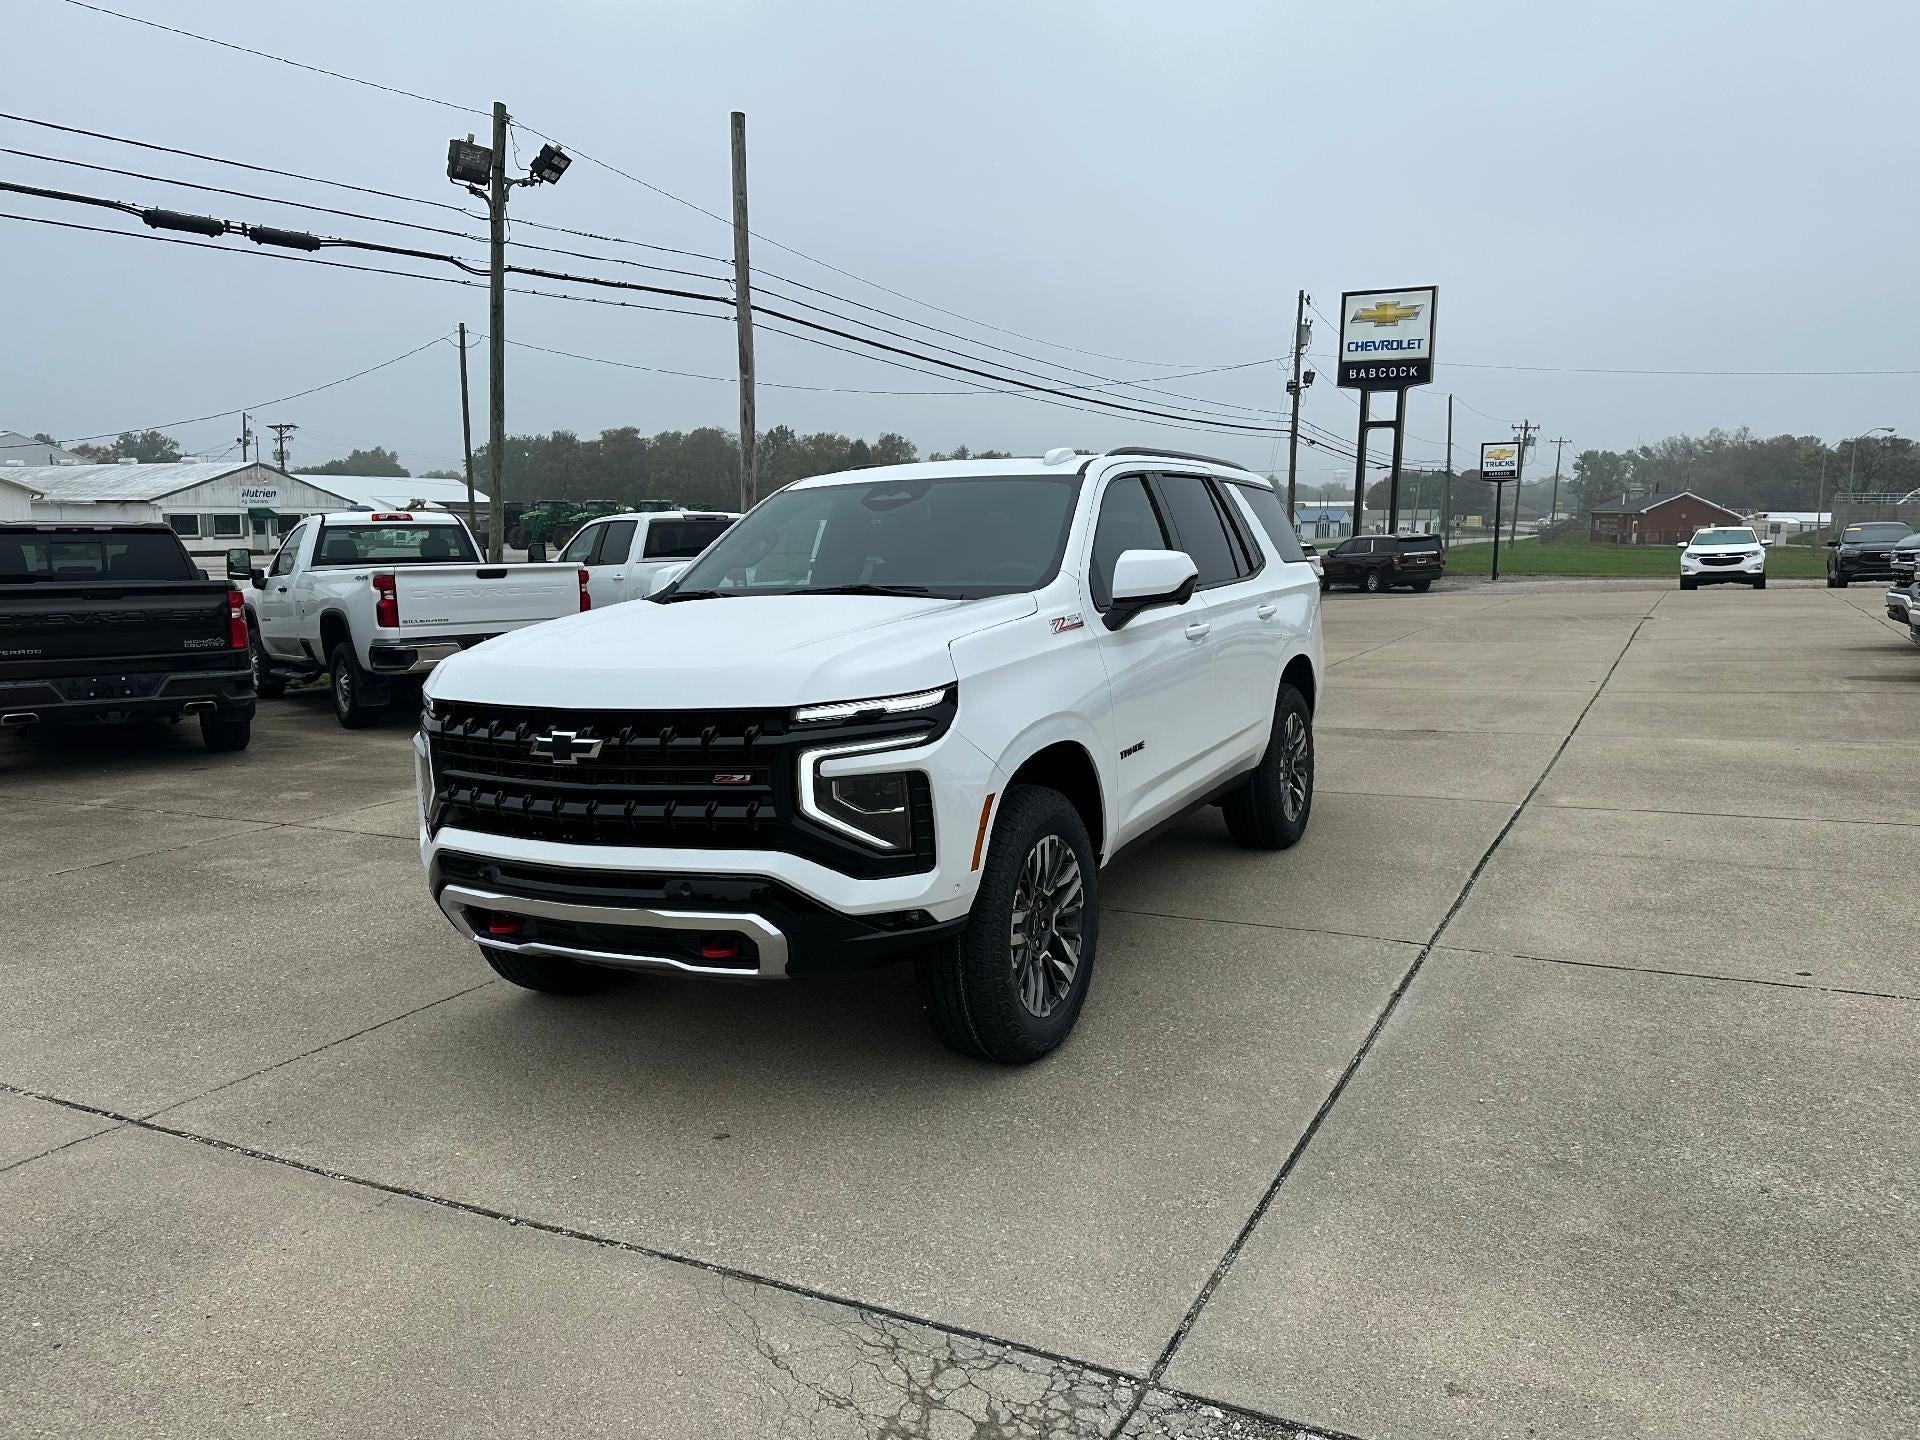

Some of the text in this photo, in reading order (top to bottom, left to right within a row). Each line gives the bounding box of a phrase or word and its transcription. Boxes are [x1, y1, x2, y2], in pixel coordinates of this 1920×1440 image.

[1347, 338, 1424, 353] CHEVROLET
[1349, 366, 1418, 379] BABCOCK
[241, 488, 277, 498] Nutrien
[1048, 612, 1084, 635] Z71
[713, 774, 751, 783] Z71
